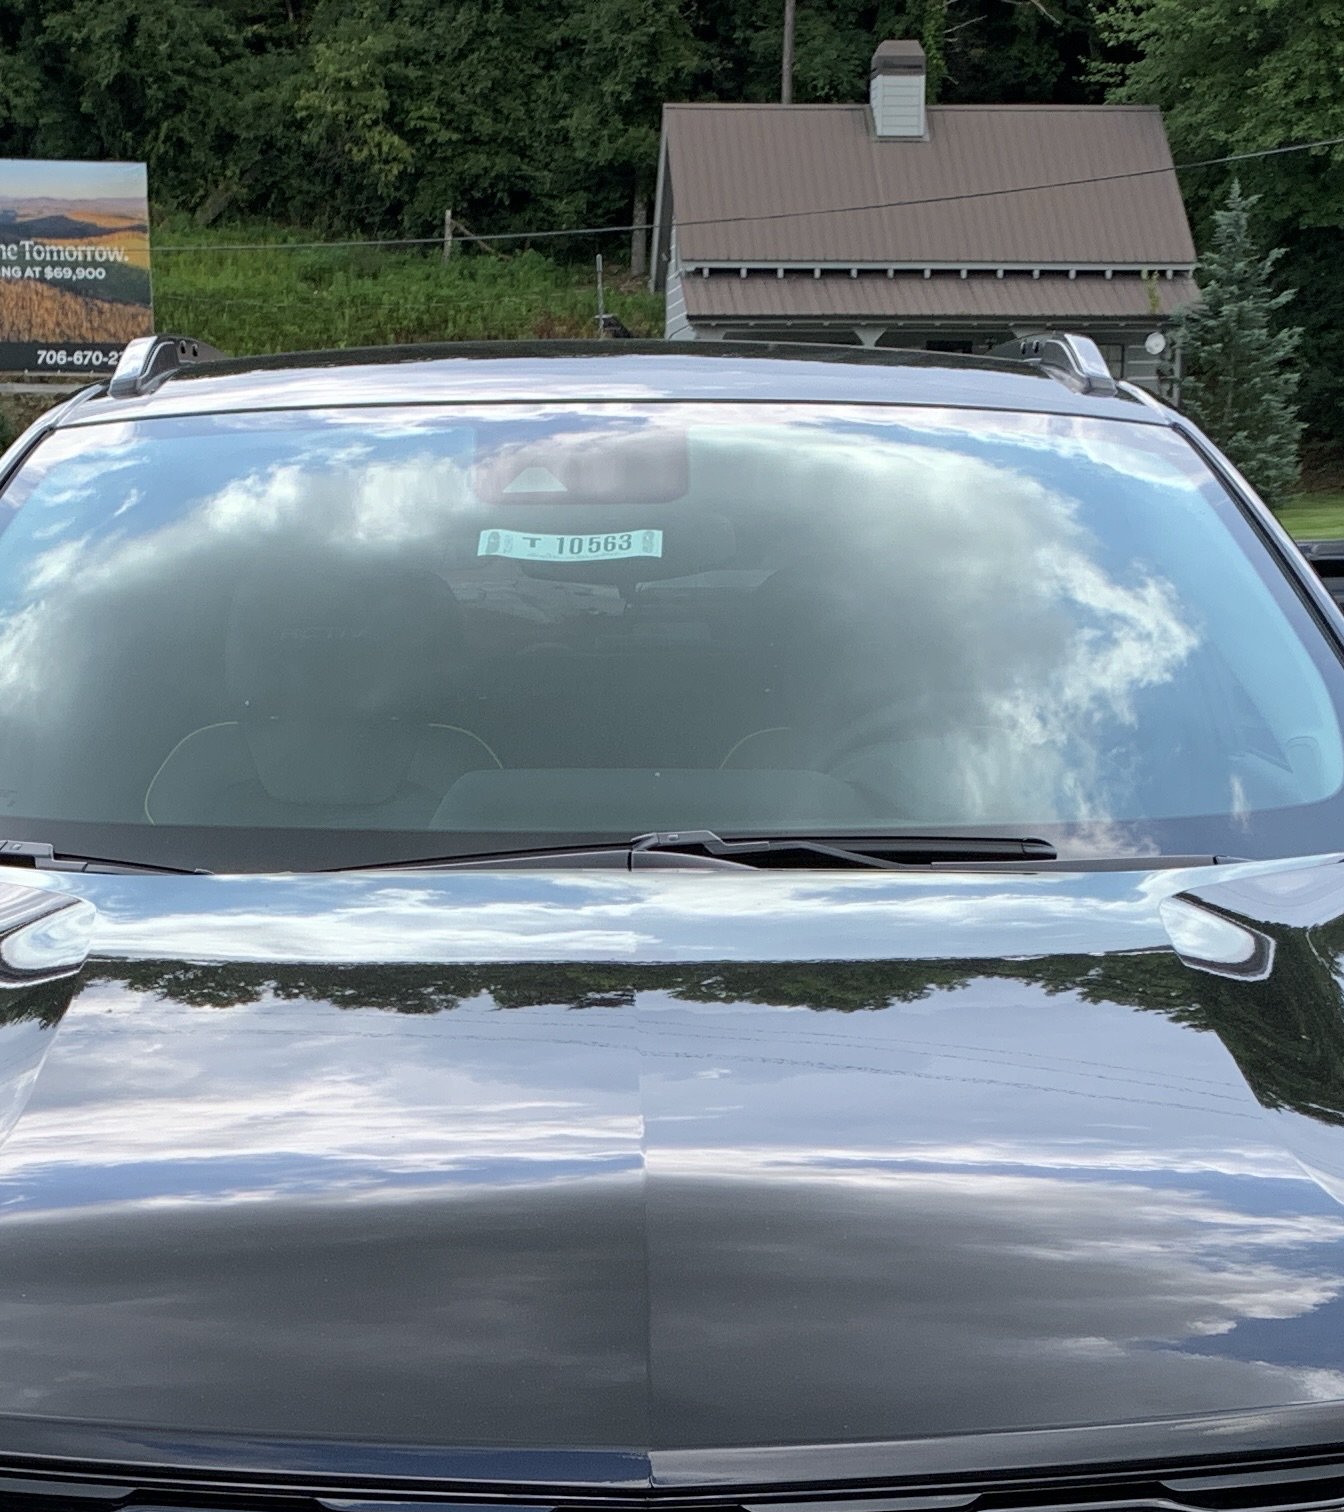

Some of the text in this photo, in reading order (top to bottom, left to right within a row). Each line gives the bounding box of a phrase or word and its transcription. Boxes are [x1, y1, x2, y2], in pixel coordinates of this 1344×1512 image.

[19, 240, 129, 262] Tomorrow.
[23, 265, 42, 279] AT
[44, 265, 107, 281] $69,900
[37, 350, 123, 366] 706-670-2
[557, 533, 633, 555] 10563
